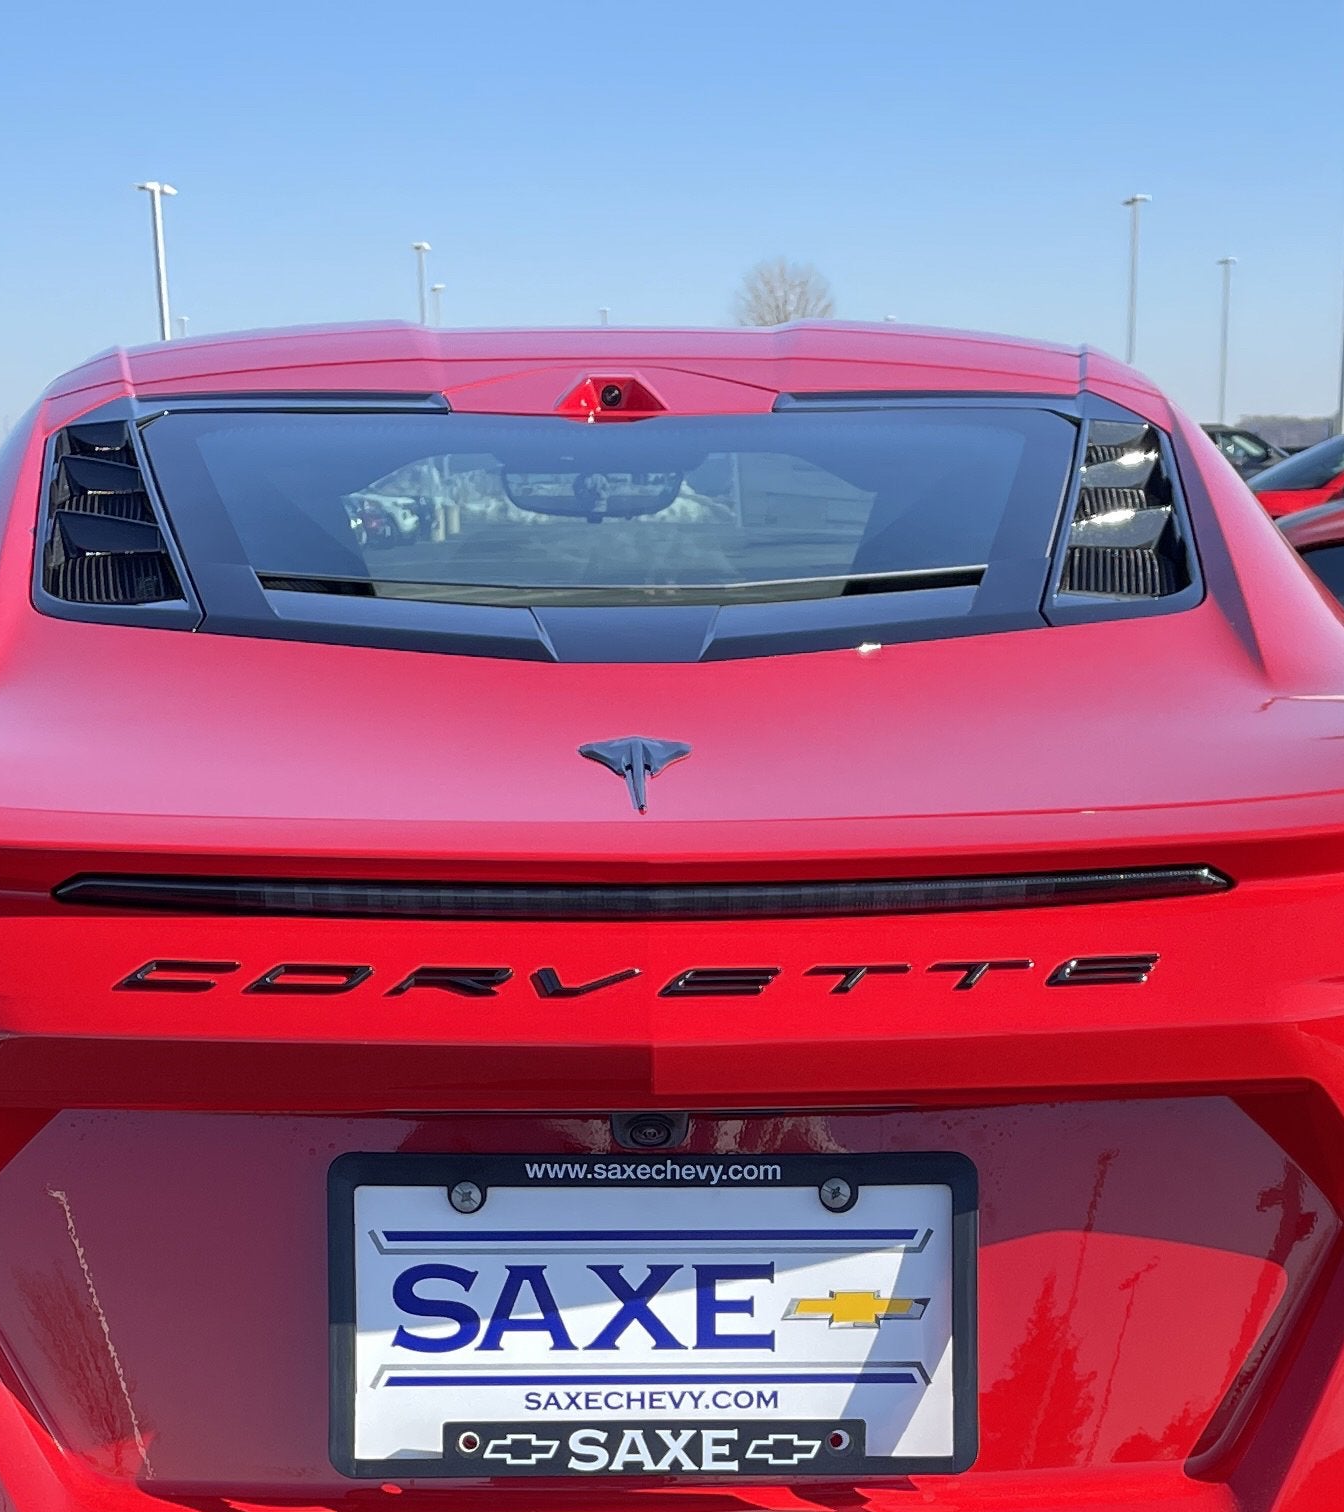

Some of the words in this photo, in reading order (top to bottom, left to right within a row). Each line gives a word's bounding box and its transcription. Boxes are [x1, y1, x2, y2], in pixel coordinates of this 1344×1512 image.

[111, 953, 1160, 998] CORVETTE
[525, 1160, 782, 1185] www.saxechevy.com
[392, 1262, 775, 1353] SAXE
[524, 1390, 779, 1411] SAXECHEVY.COM
[567, 1428, 739, 1472] SAXE
